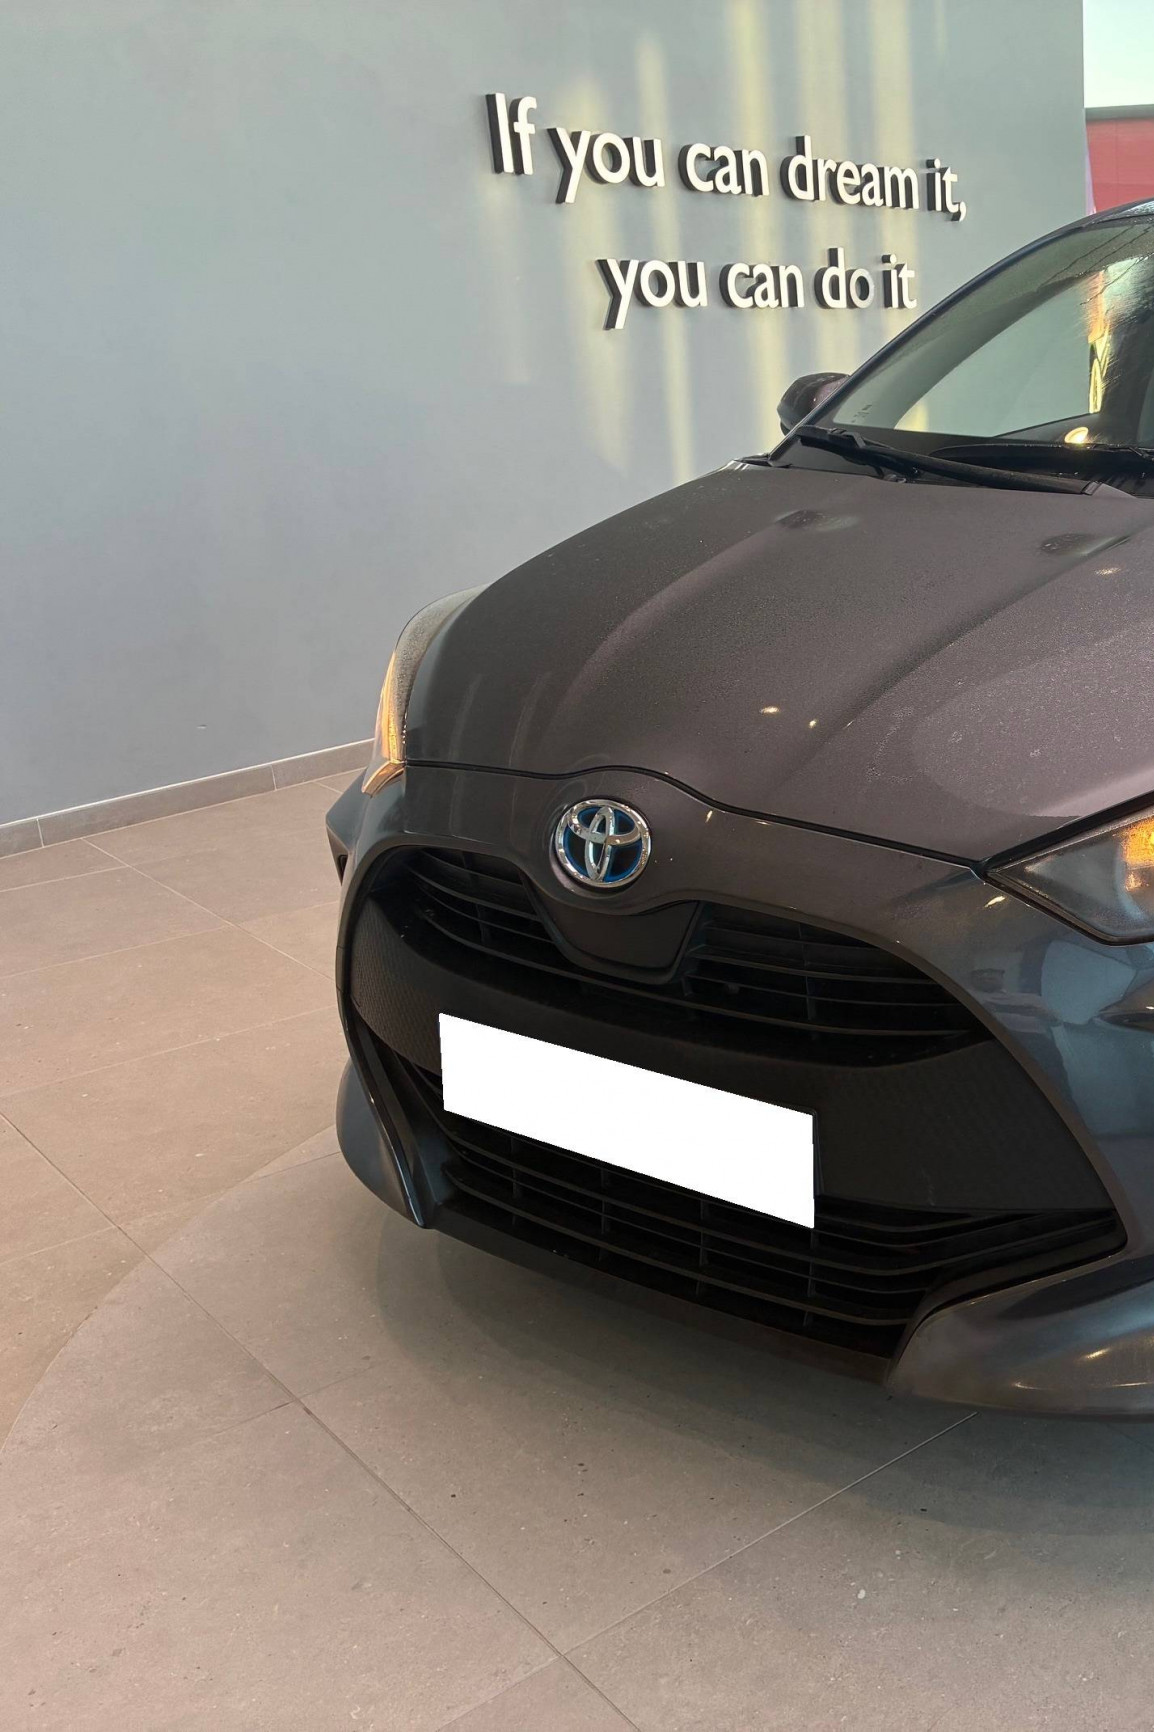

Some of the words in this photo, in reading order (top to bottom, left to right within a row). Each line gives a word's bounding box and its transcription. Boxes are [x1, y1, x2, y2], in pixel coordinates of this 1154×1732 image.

[486, 92, 537, 175] If
[547, 127, 665, 203] you
[678, 143, 770, 196] can
[780, 135, 919, 209] dream
[926, 158, 967, 222] it,
[596, 258, 707, 330] you
[719, 262, 804, 309] can
[814, 247, 875, 310] do
[882, 254, 917, 310] it
